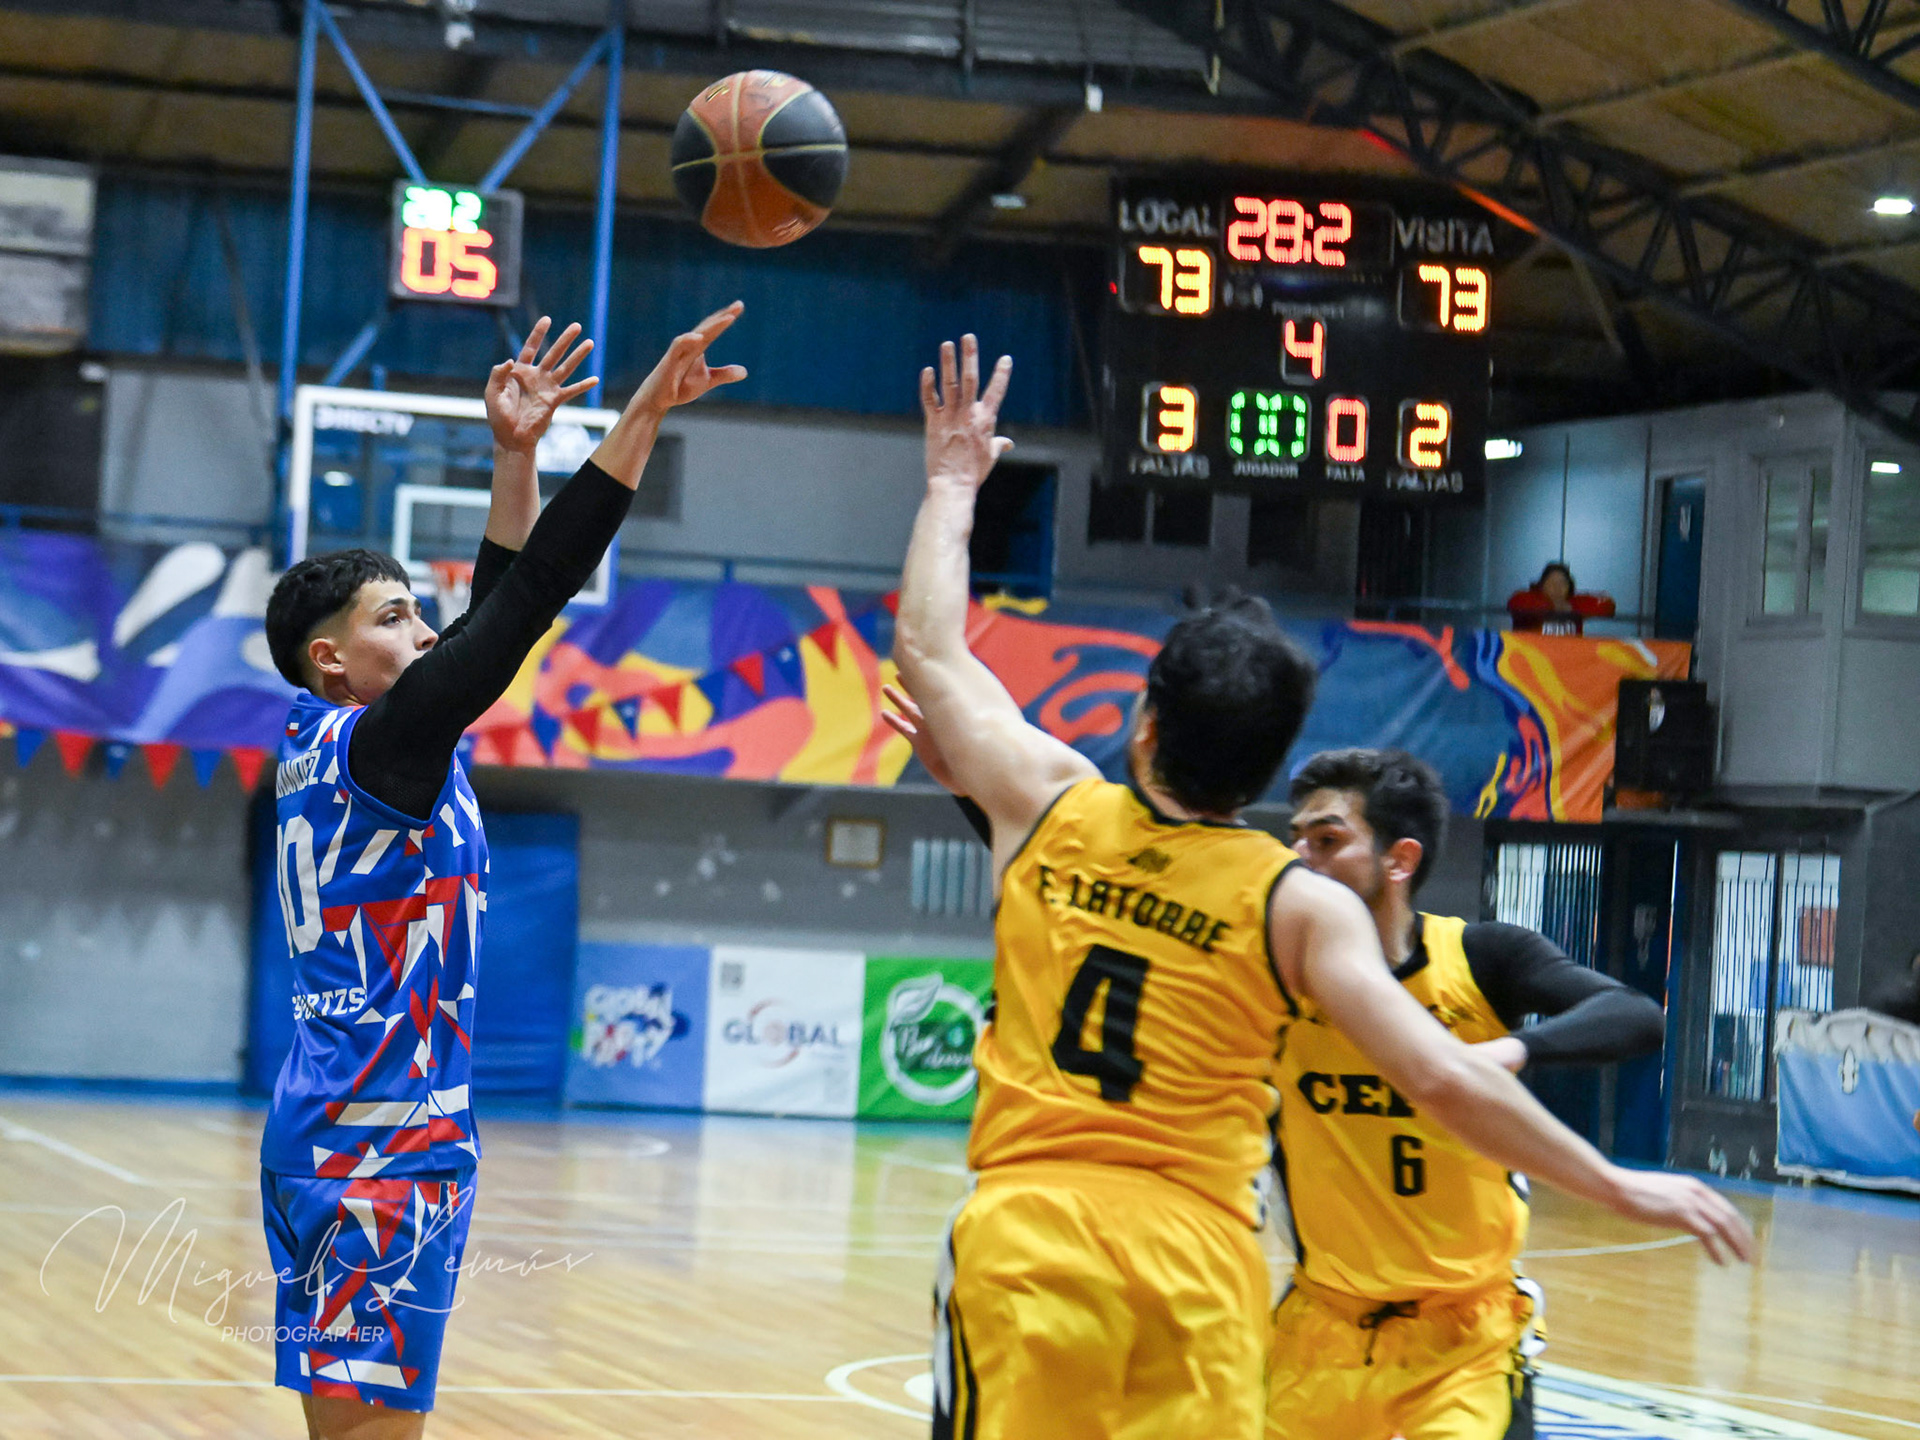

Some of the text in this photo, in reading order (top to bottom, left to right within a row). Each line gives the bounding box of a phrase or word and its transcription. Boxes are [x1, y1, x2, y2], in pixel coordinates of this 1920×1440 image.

[1118, 199, 1216, 237] LOCAL
[1227, 196, 1352, 268] 28:2
[1398, 217, 1495, 255] VISITA
[401, 227, 498, 299] 05
[1138, 246, 1212, 316] 73
[1418, 264, 1488, 332] 73
[1284, 320, 1324, 380] 4
[1158, 386, 1197, 452] 3
[1327, 398, 1367, 462] 0
[1409, 403, 1449, 469] 2
[723, 1018, 842, 1047] GLOBAL
[1051, 943, 1150, 1104] 4
[1391, 1134, 1427, 1197] 6
